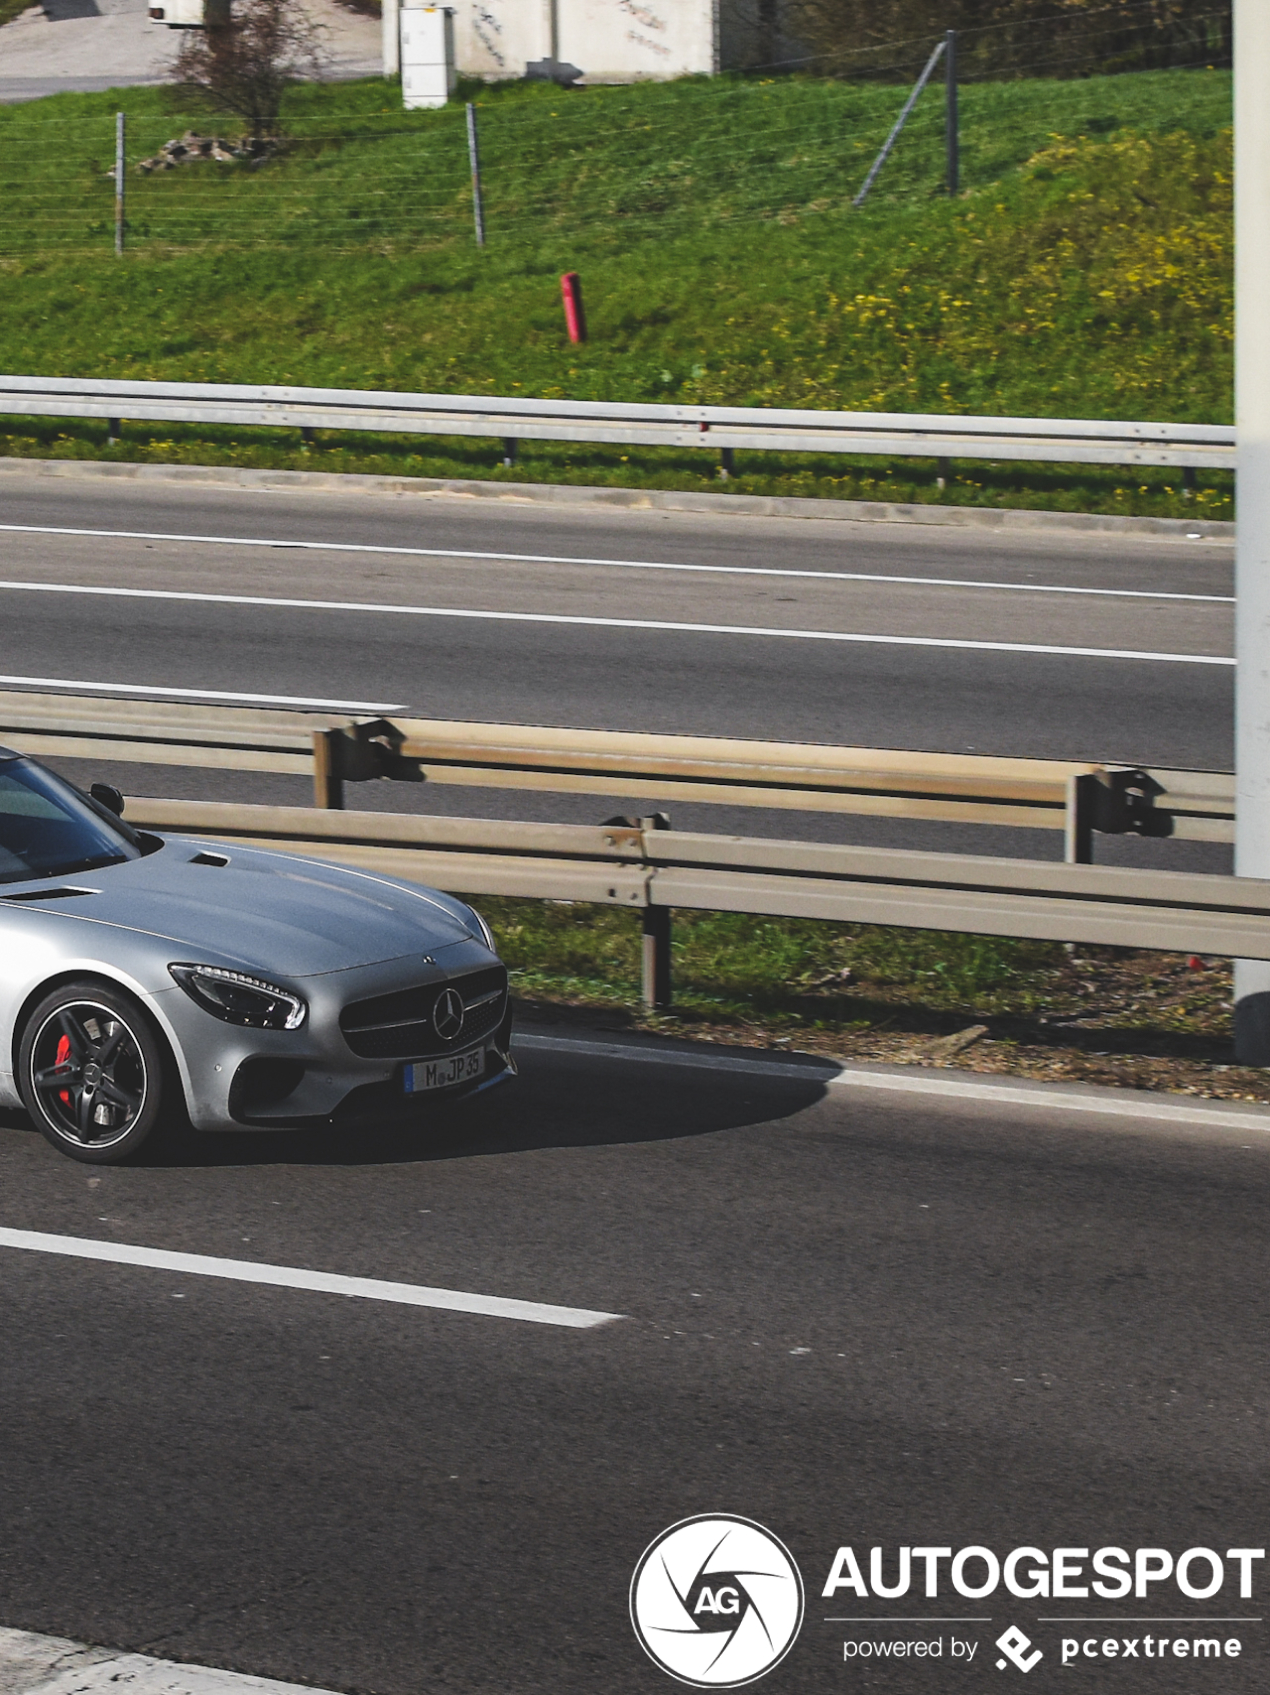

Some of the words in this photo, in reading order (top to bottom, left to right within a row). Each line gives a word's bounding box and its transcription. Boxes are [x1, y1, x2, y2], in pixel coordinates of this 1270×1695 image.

[426, 1063, 437, 1087] M
[447, 1058, 465, 1082] JP
[466, 1052, 479, 1076] 35
